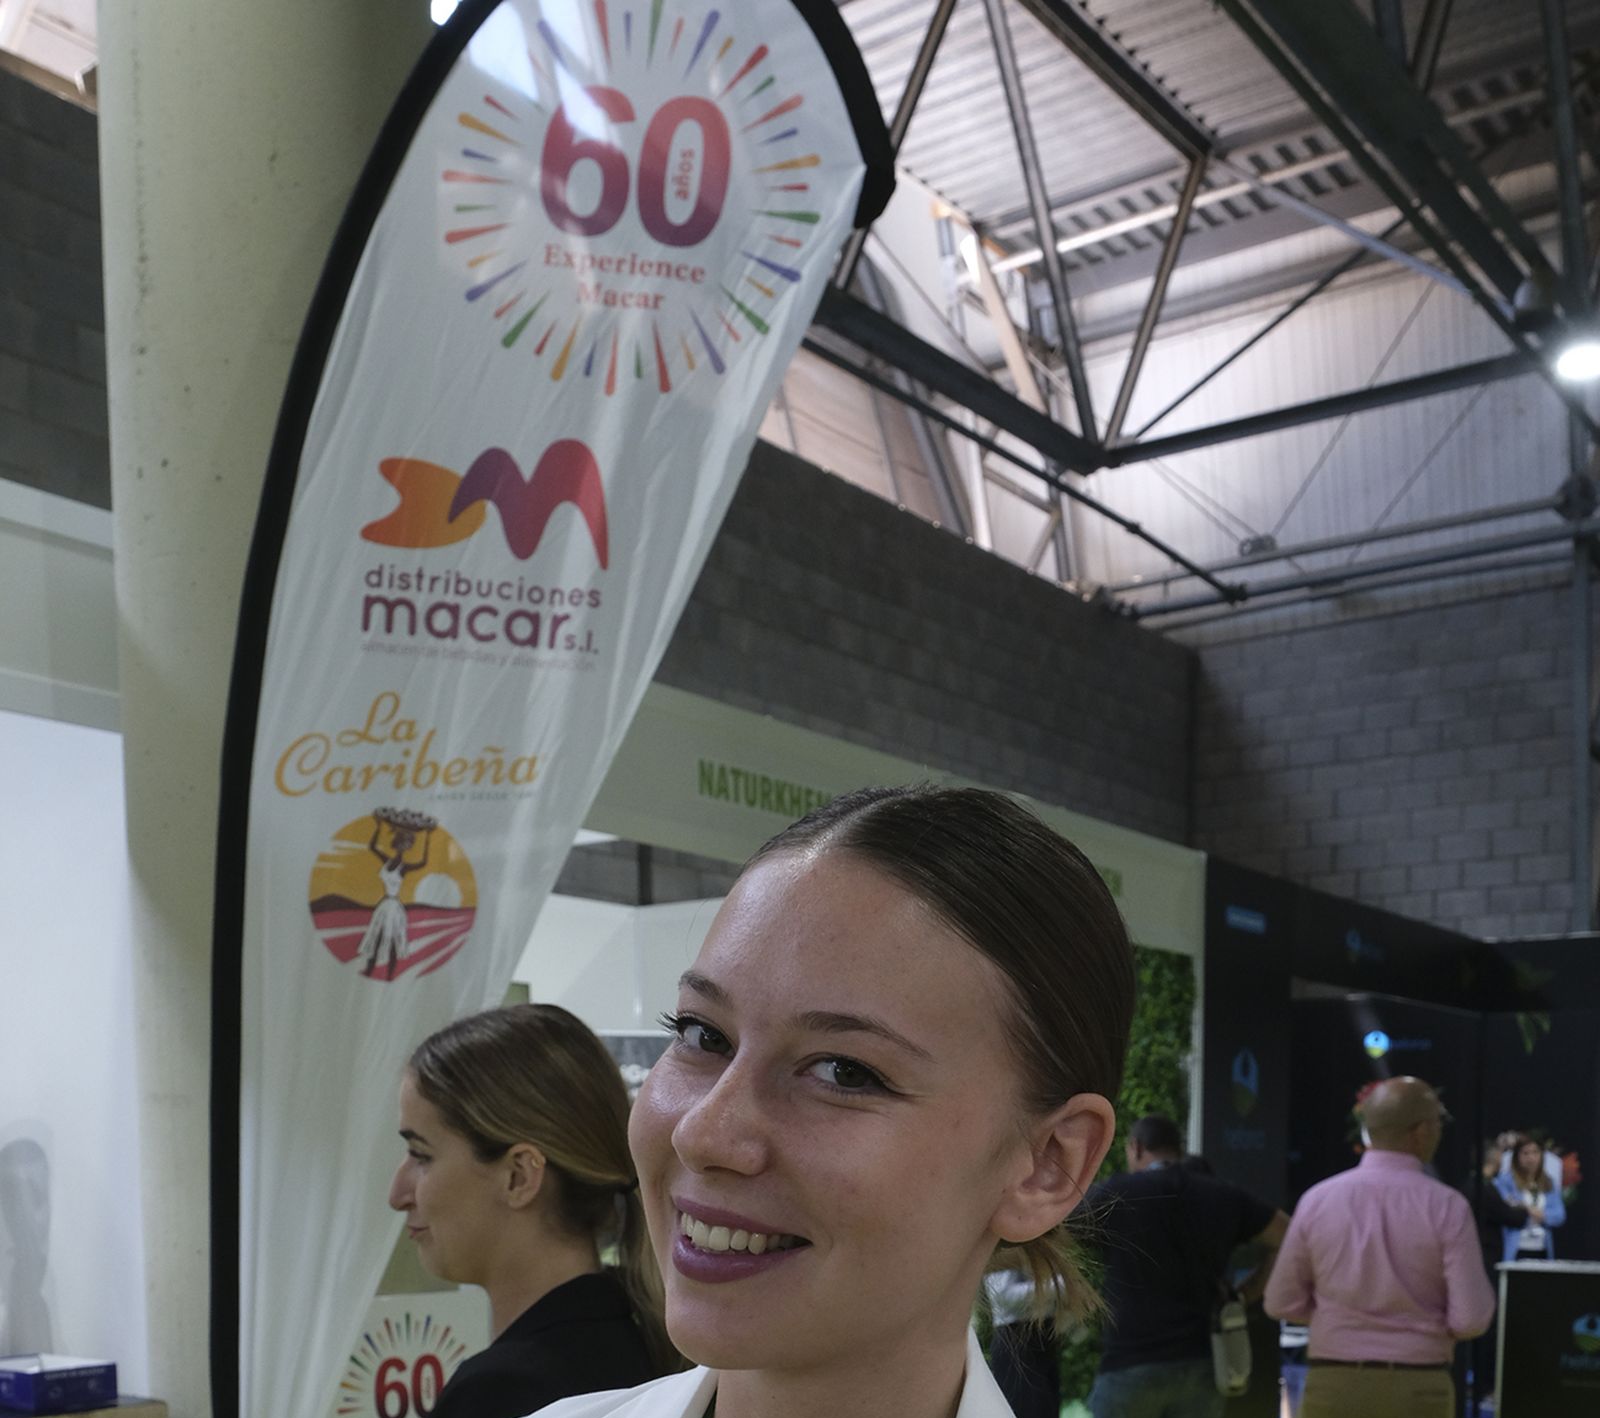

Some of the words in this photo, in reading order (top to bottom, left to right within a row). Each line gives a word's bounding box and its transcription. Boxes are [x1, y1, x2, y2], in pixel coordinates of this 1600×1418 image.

[540, 86, 731, 247] 60
[543, 243, 706, 284] Experience
[576, 279, 665, 310] Macar
[364, 564, 602, 608] distribuciones
[361, 594, 570, 649] macar
[564, 630, 599, 655] s.l.
[336, 691, 418, 746] La
[274, 728, 539, 797] Caribeña
